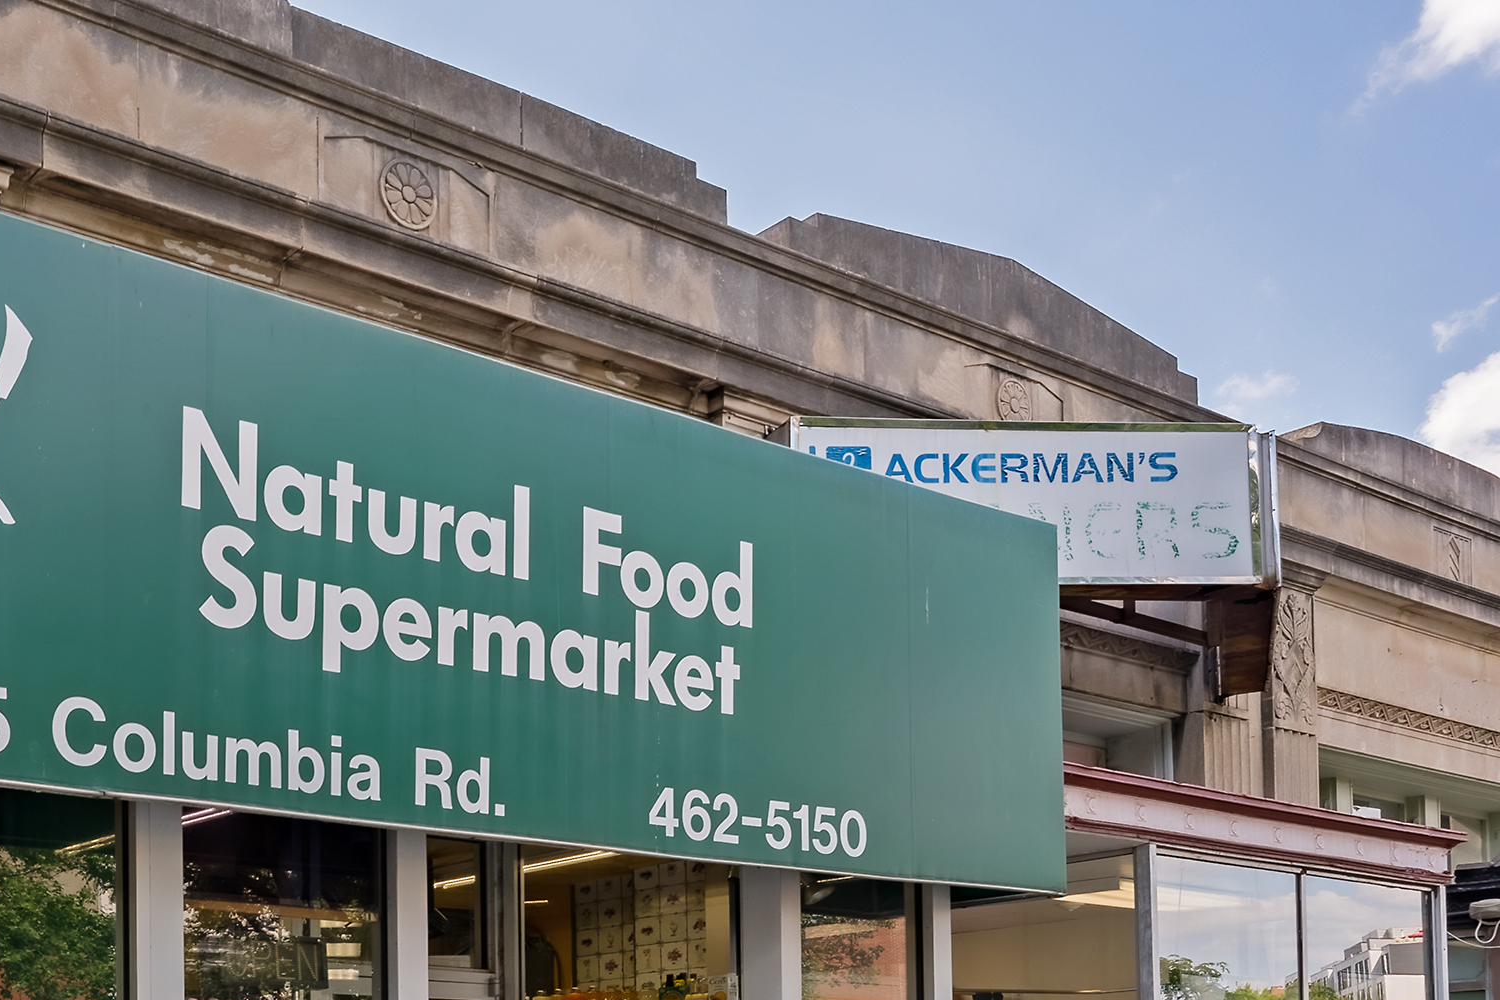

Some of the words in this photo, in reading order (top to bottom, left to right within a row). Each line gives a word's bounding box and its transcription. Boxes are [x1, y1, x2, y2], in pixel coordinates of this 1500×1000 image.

[181, 405, 530, 581] Natural
[582, 506, 753, 628] Food
[885, 452, 1178, 483] ACKERMAN'S
[199, 524, 740, 715] Supermarket
[51, 696, 381, 801] Columbia
[414, 747, 506, 817] Rd.
[648, 787, 868, 858] 462-5150
